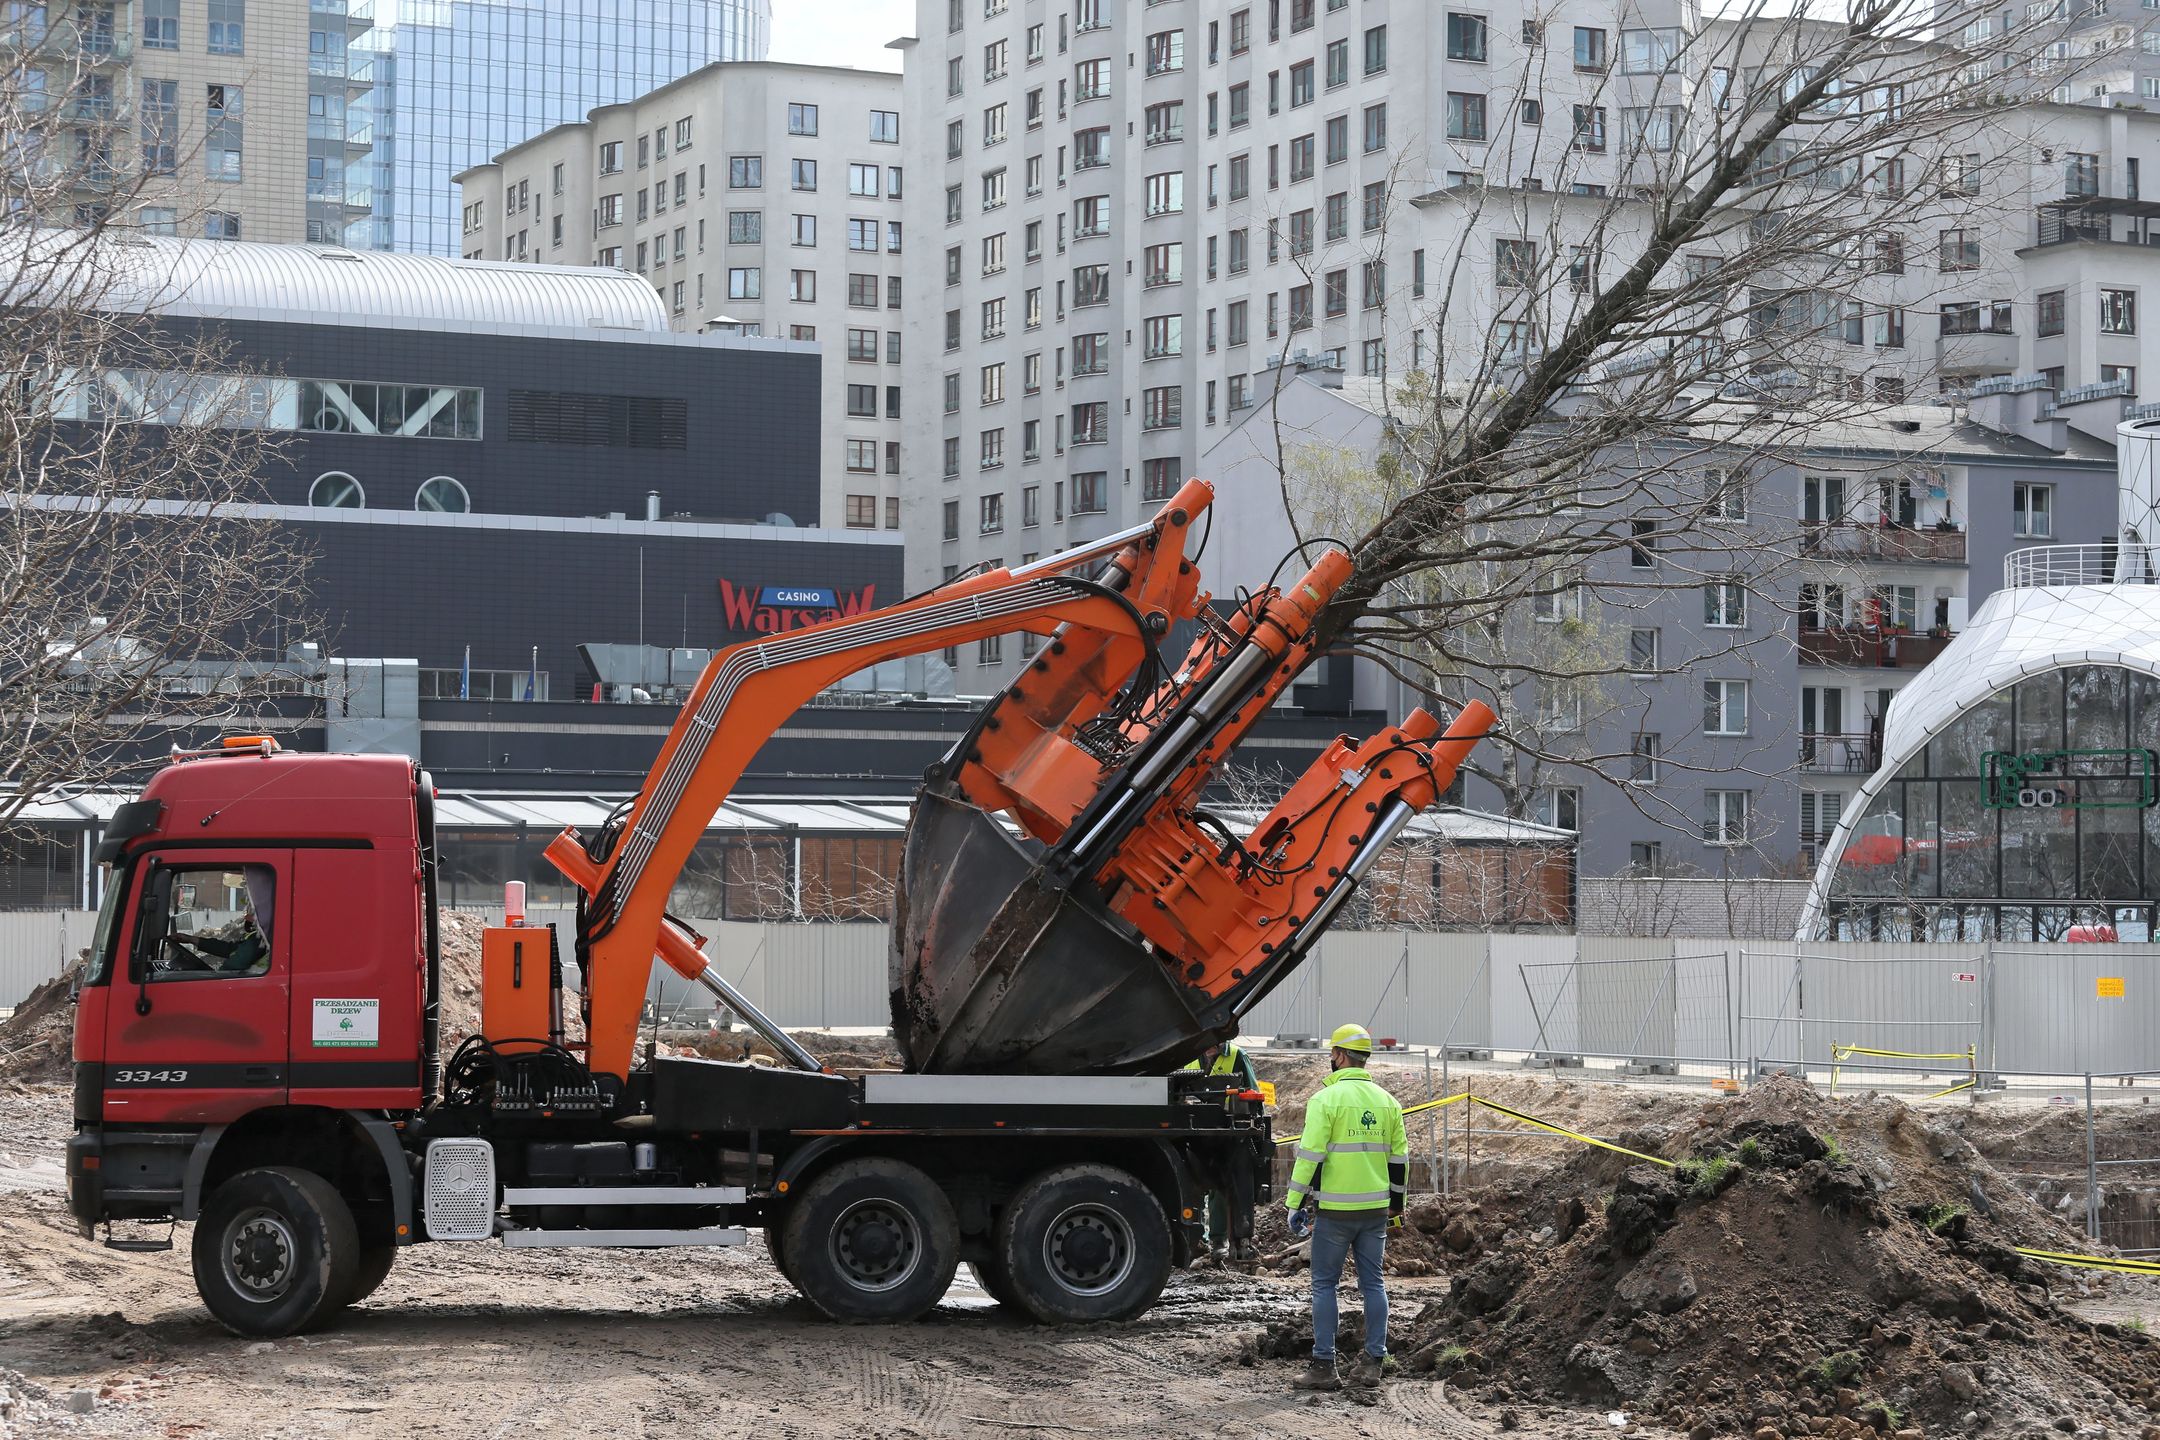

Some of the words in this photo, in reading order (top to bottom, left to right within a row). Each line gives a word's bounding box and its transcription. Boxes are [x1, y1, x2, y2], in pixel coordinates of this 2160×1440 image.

[777, 591, 820, 602] CASINO
[315, 1000, 378, 1008] PRZESADZANIE
[331, 1007, 362, 1015] DRZEW
[114, 1070, 188, 1083] 3343
